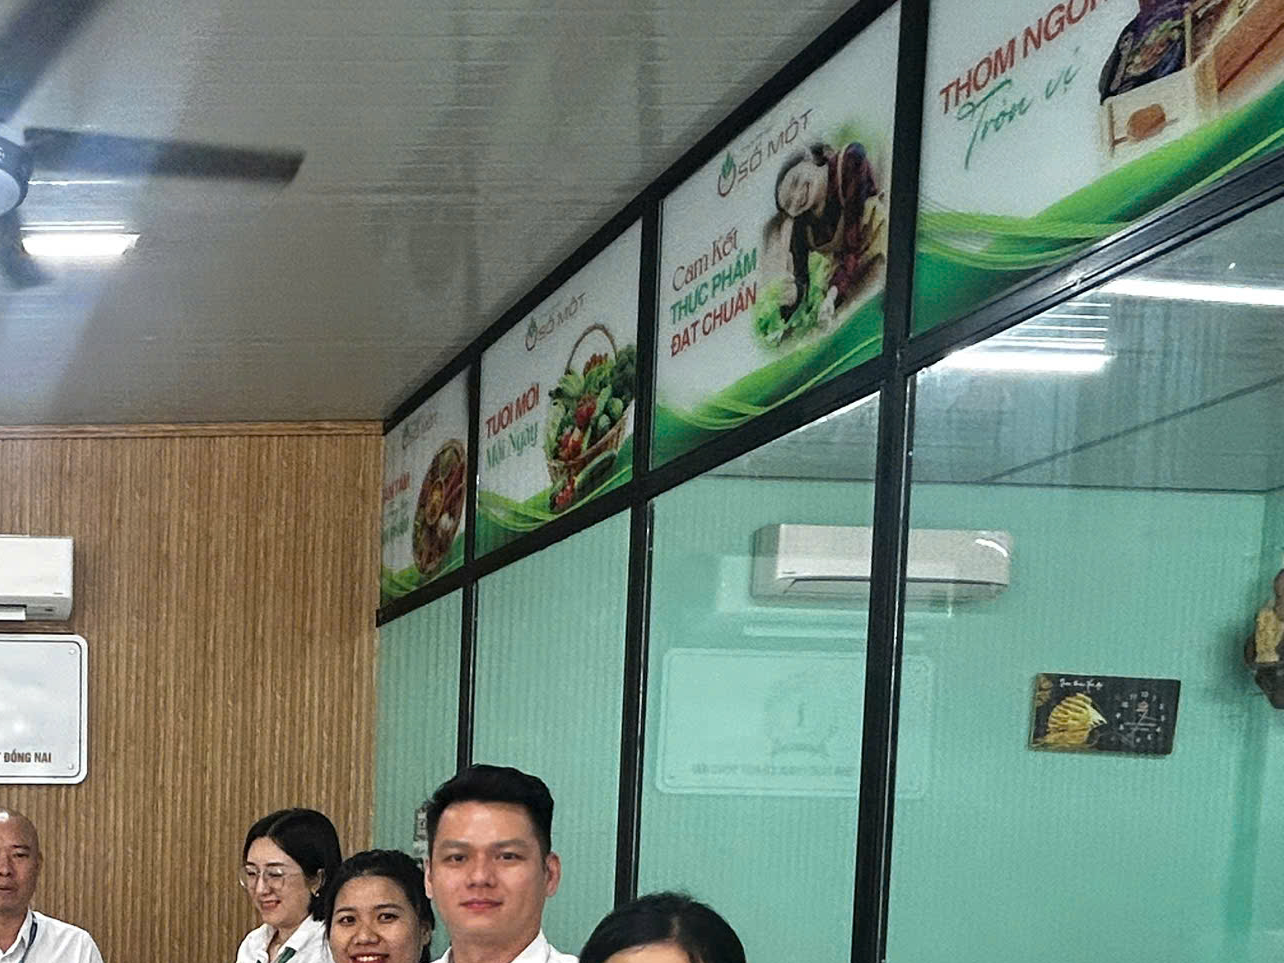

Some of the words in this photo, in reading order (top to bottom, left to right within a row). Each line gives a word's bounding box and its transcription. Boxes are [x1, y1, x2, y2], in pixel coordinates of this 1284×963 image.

[1023, 0, 1109, 58] NGO
[3, 748, 31, 763] ĐỒNG
[34, 752, 52, 763] NAI
